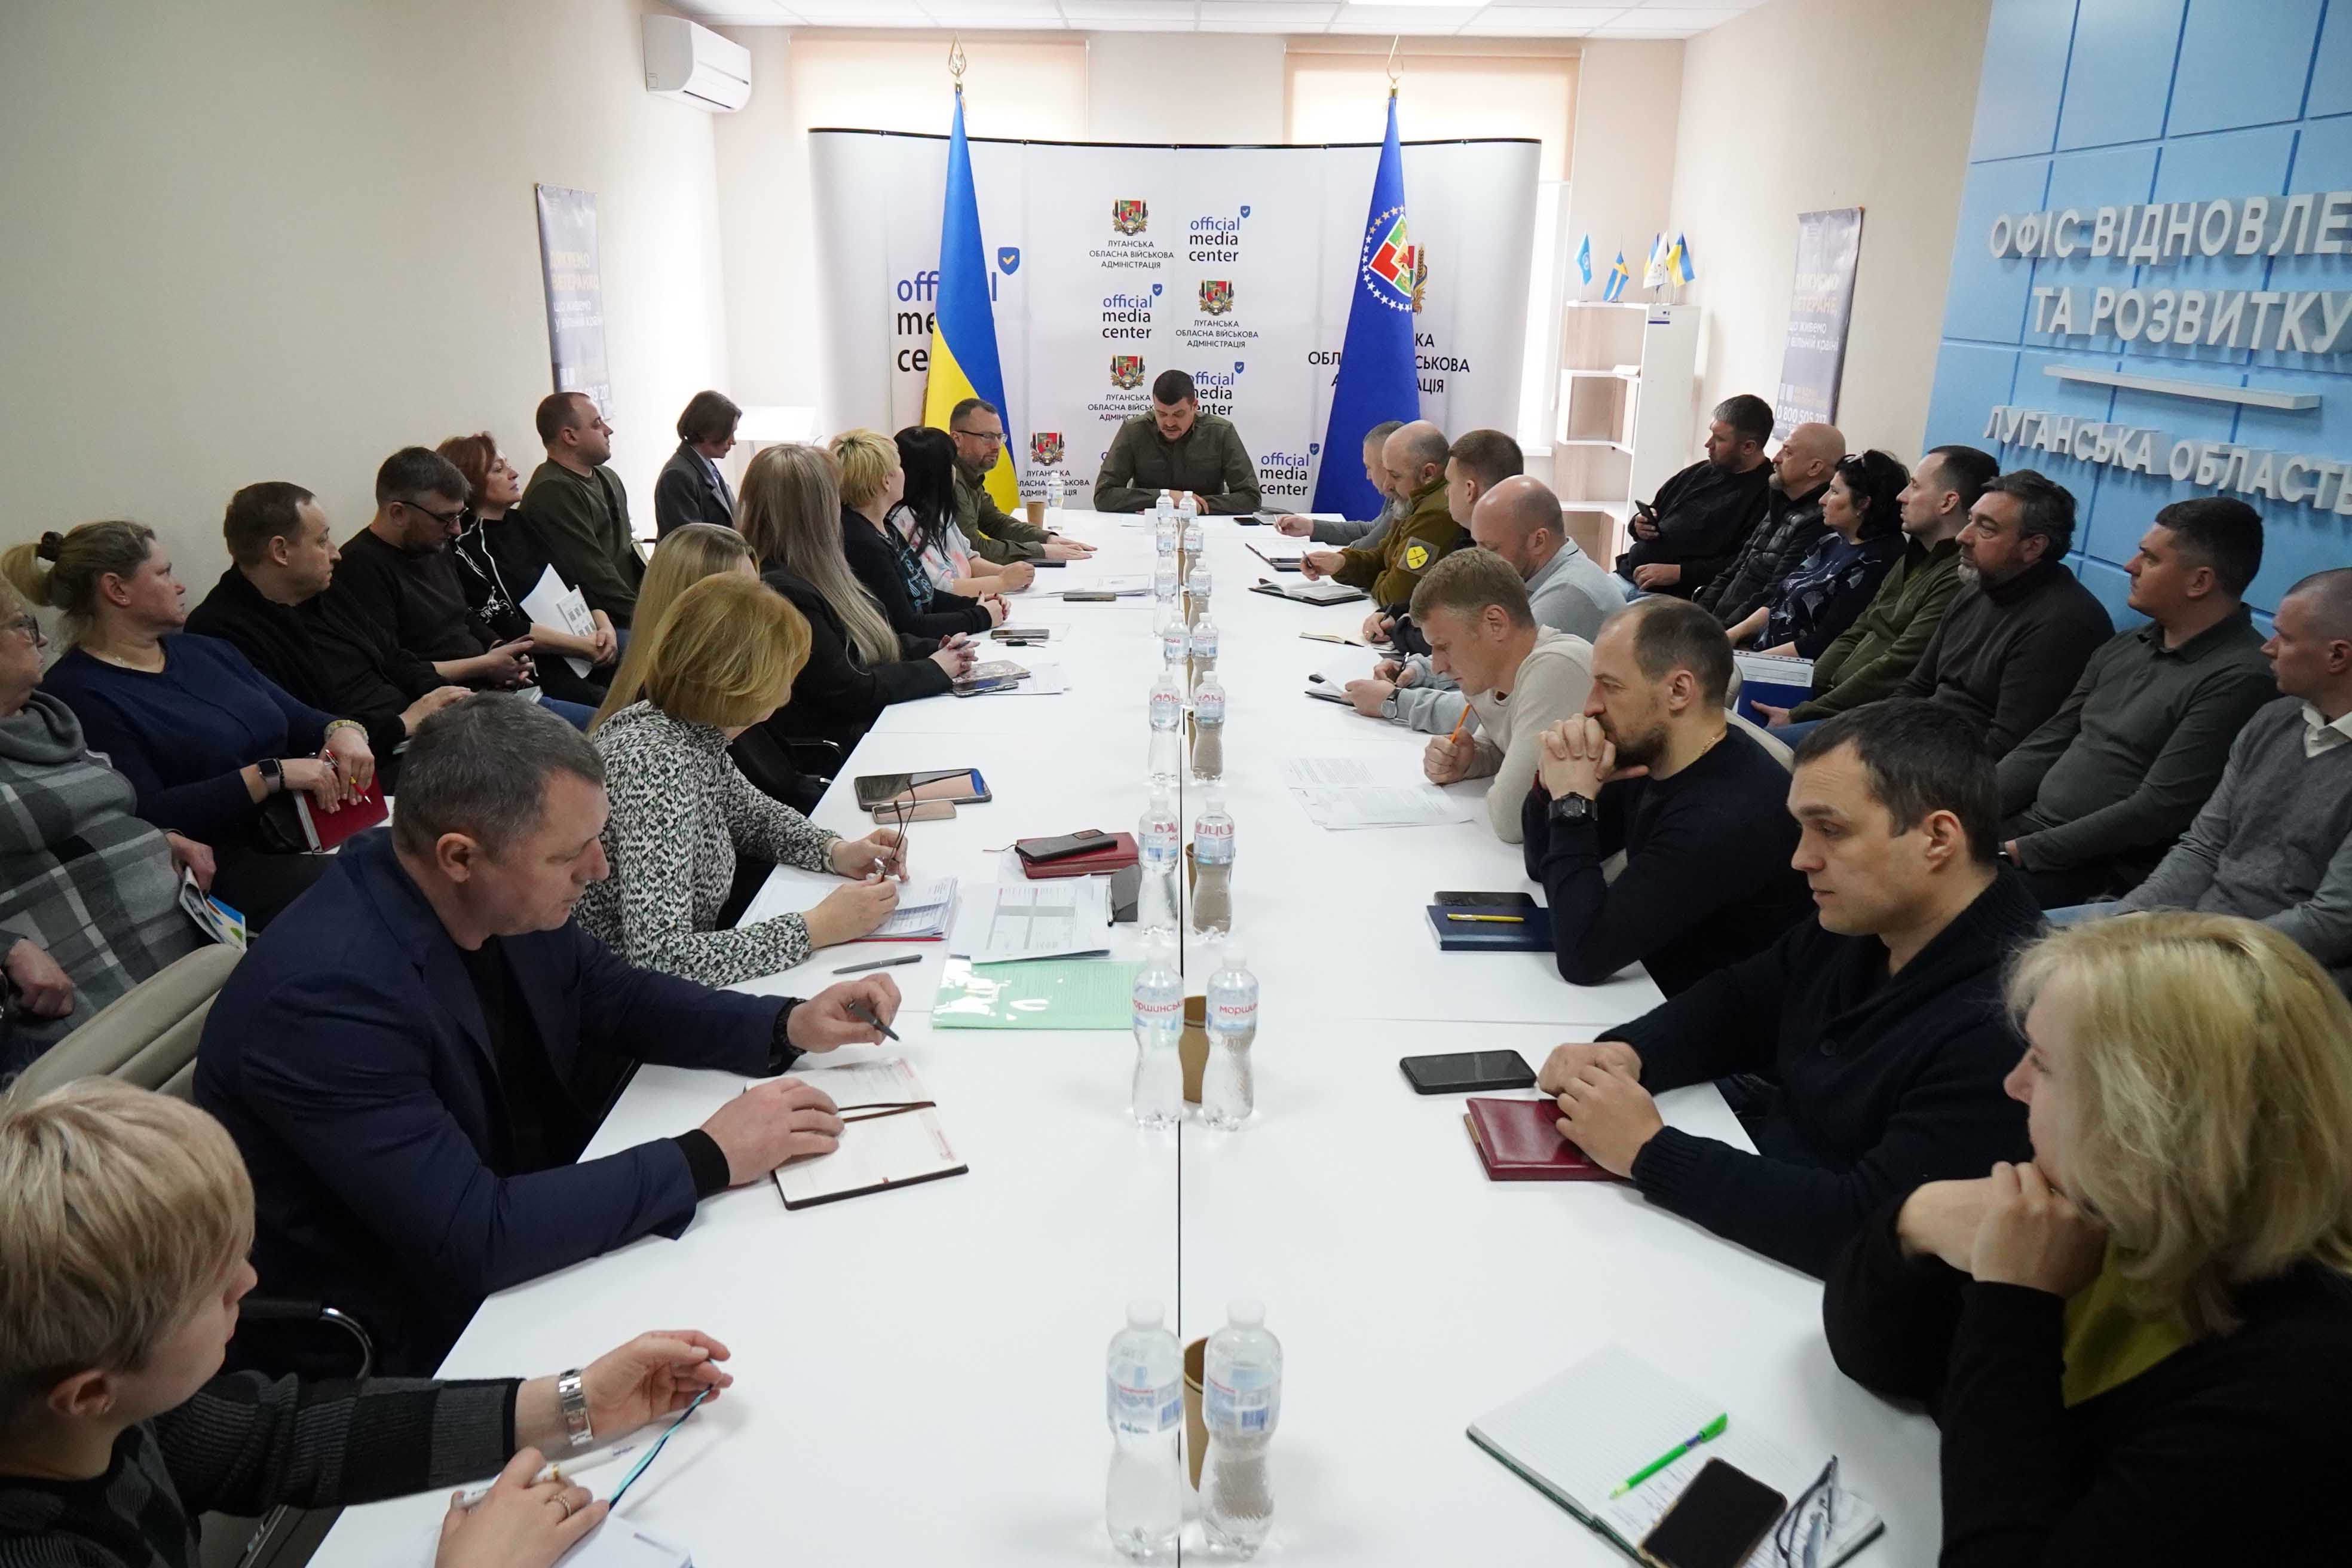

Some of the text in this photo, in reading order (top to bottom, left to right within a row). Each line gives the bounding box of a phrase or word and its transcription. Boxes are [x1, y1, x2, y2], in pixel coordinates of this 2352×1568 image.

[1190, 216, 1240, 231] official
[1989, 191, 2352, 265] ОФІС ВІДНОВЛЕ
[1108, 240, 1154, 248] ЛУГАНСЬКА
[1189, 231, 1238, 246] media
[1130, 250, 1174, 259] ВІЙСЬКОВА
[1189, 249, 1239, 262] center
[1101, 261, 1161, 269] АДМІНІСТРАЦІЯ
[898, 271, 997, 301] offl
[1103, 294, 1153, 308] official
[1102, 308, 1151, 323] media
[2034, 286, 2352, 354] ТА РОЗВИТКУ
[1102, 326, 1152, 339] center
[1216, 330, 1258, 338] ВІЙСЬКОВА
[1187, 339, 1246, 348] АДМІНІСТРАЦІЯ
[1416, 356, 1470, 373] СЬКОВА
[1197, 403, 1233, 415] nter
[1261, 452, 1309, 467] official
[1983, 405, 2352, 515] ЛУГАНСЬКА ОБЛАСТЬ
[1260, 466, 1307, 480] media
[1018, 479, 1046, 488] ЛАСНА
[1259, 483, 1308, 496] center
